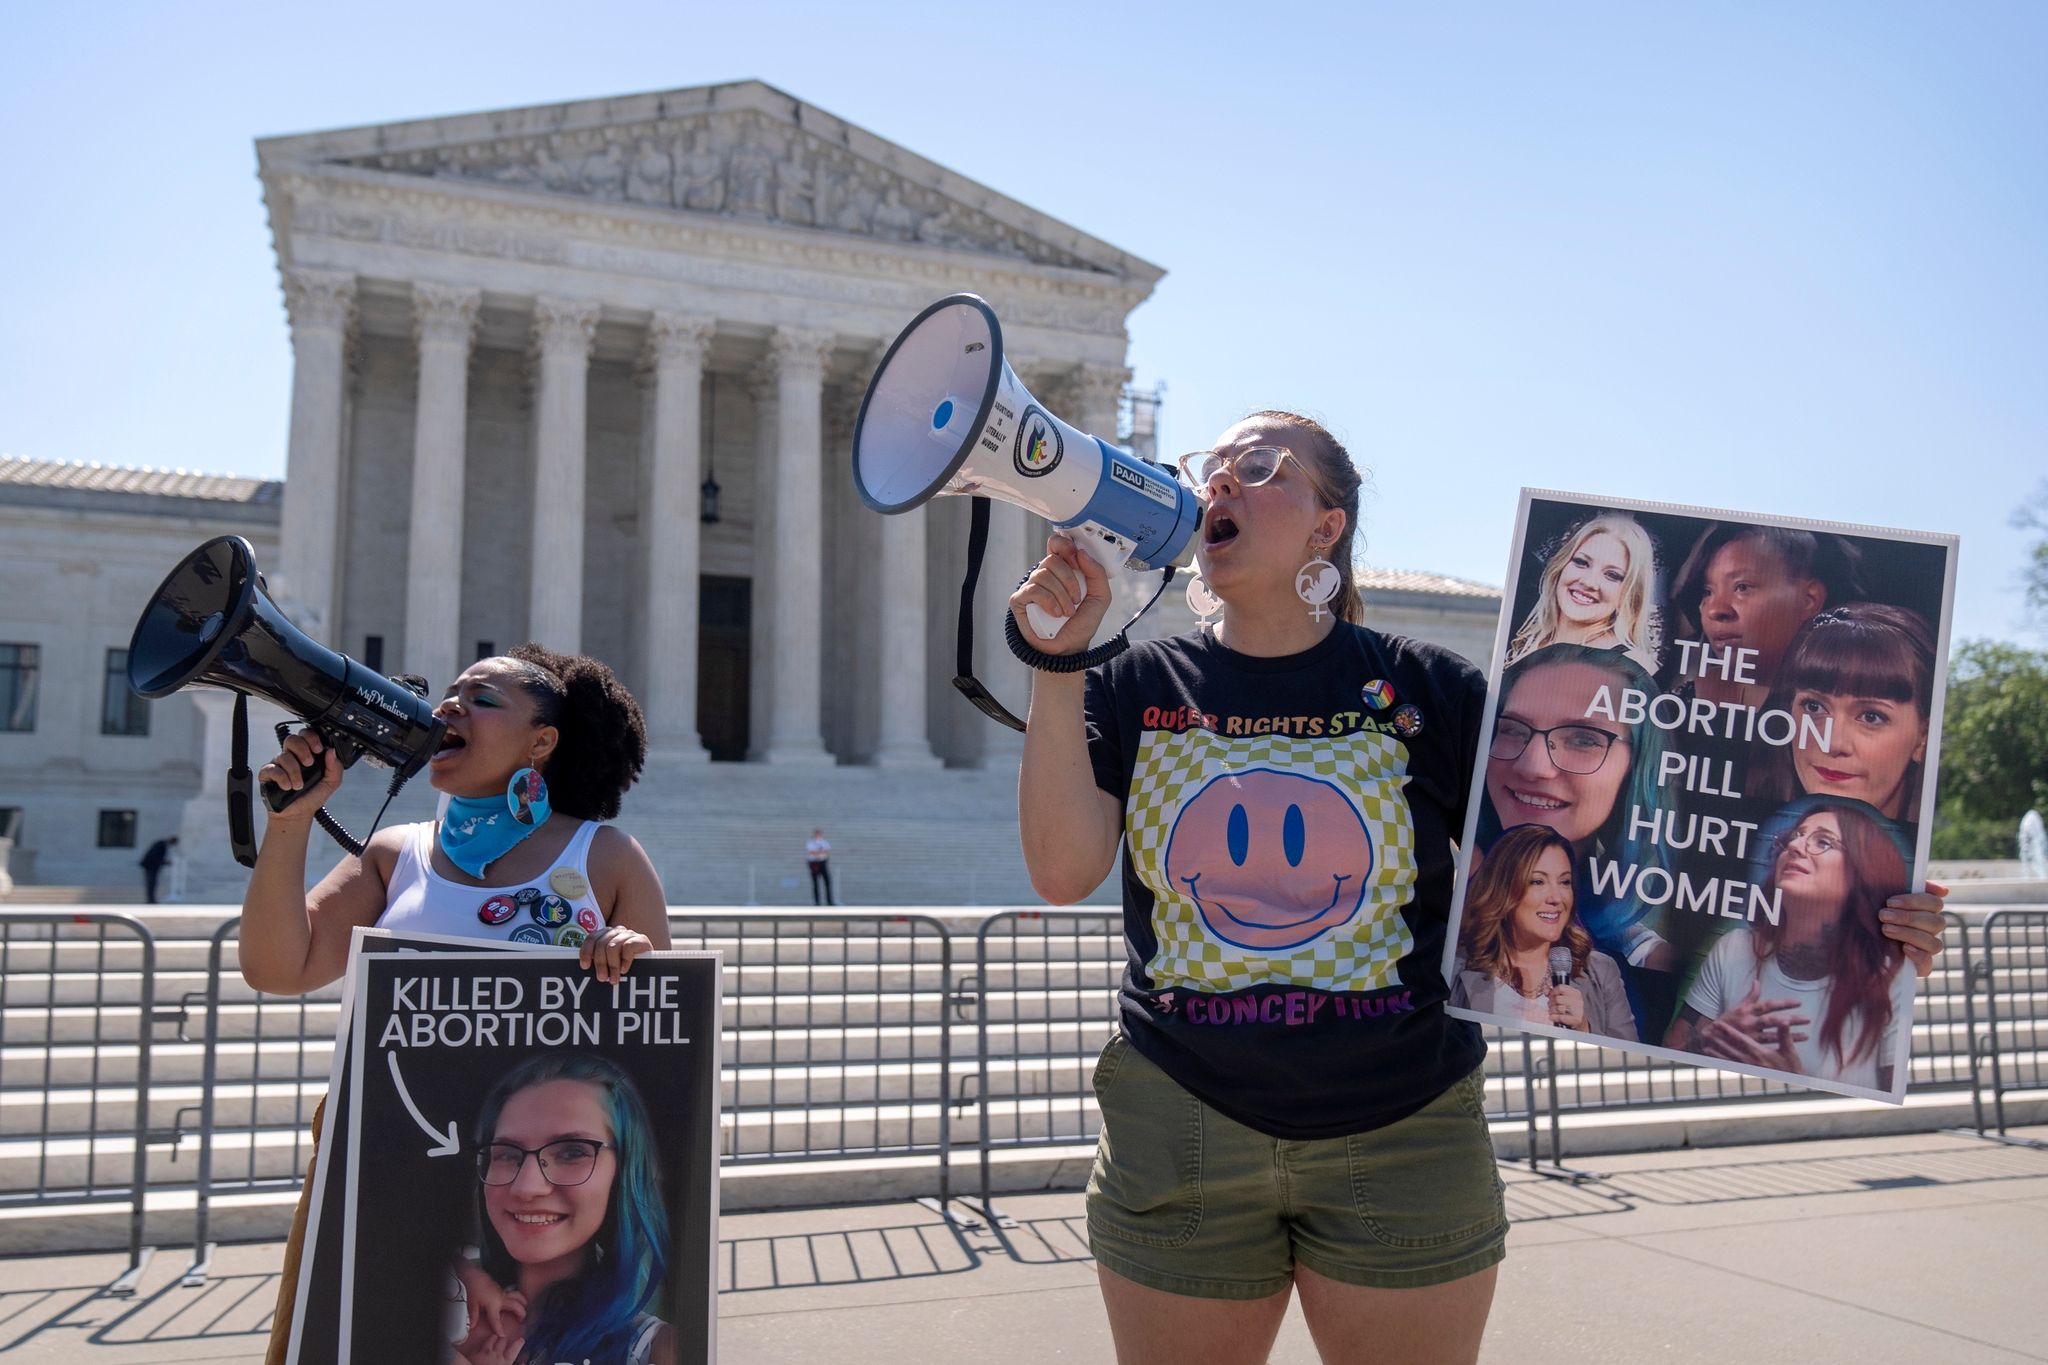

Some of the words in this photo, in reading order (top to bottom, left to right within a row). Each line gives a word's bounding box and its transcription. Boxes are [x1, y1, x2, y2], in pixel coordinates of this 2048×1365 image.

[995, 401, 1014, 420] ABORTION
[997, 418, 1003, 427] IS
[981, 438, 999, 453] MURDER
[985, 426, 1007, 443] LITERALLY
[1116, 465, 1142, 486] PAAU
[1674, 639, 1759, 685] THE
[1143, 705, 1219, 731] QUEER
[1226, 715, 1325, 736] RIGHTS
[1584, 685, 1833, 753] ABORTION
[1657, 751, 1741, 798] PILL
[1628, 805, 1758, 859] HURT
[1589, 857, 1783, 926] WOMEN
[392, 977, 524, 1011] KILLED
[540, 977, 591, 1010] BY
[611, 976, 680, 1009] THE
[378, 1012, 601, 1048] ABORTION
[617, 1011, 691, 1045] PILL
